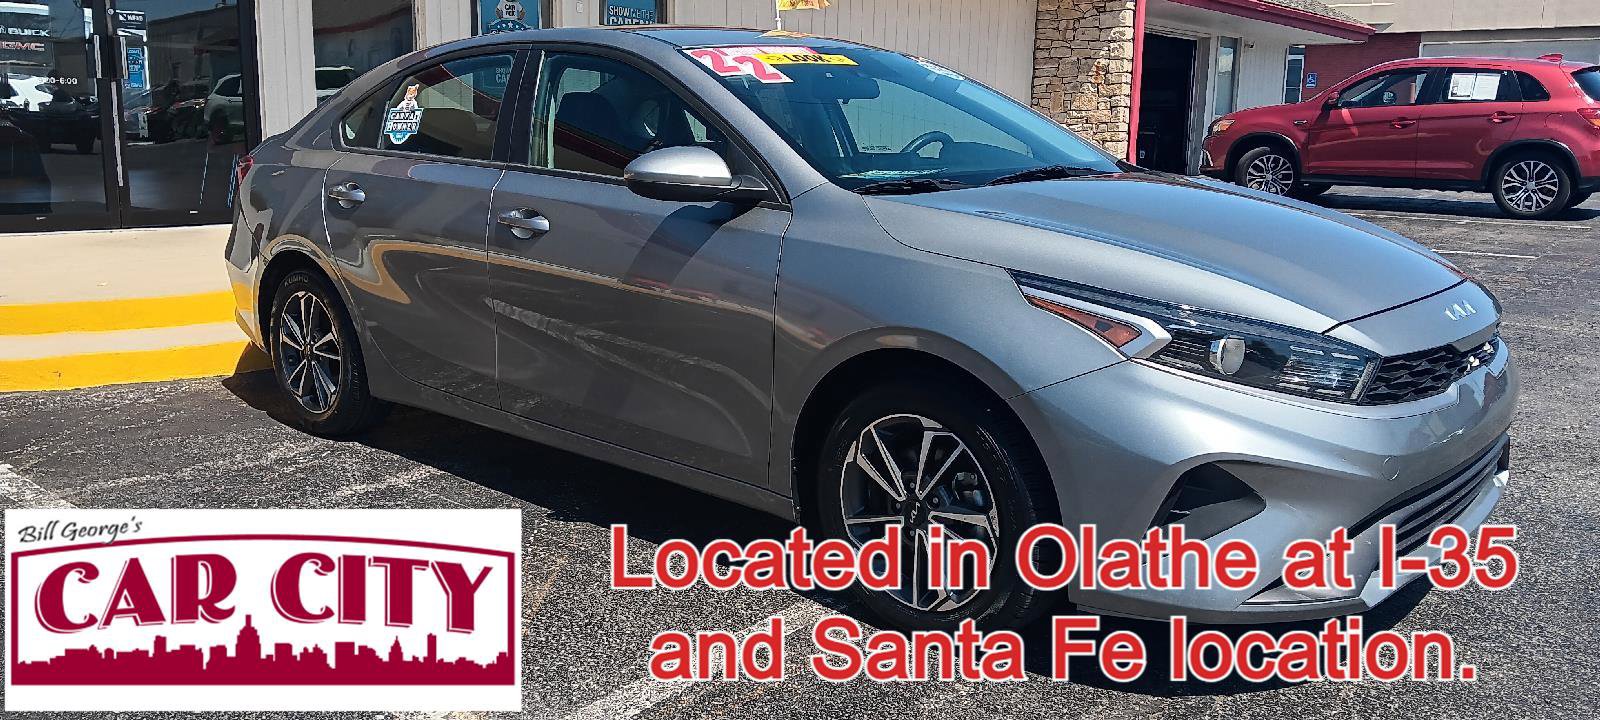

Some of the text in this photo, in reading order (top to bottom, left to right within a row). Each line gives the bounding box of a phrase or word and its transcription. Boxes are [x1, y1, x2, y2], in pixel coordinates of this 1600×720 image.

[609, 5, 630, 17] SHOW
[7, 27, 51, 37] BUICK
[1, 41, 45, 51] GMC
[782, 53, 830, 64] LOOK
